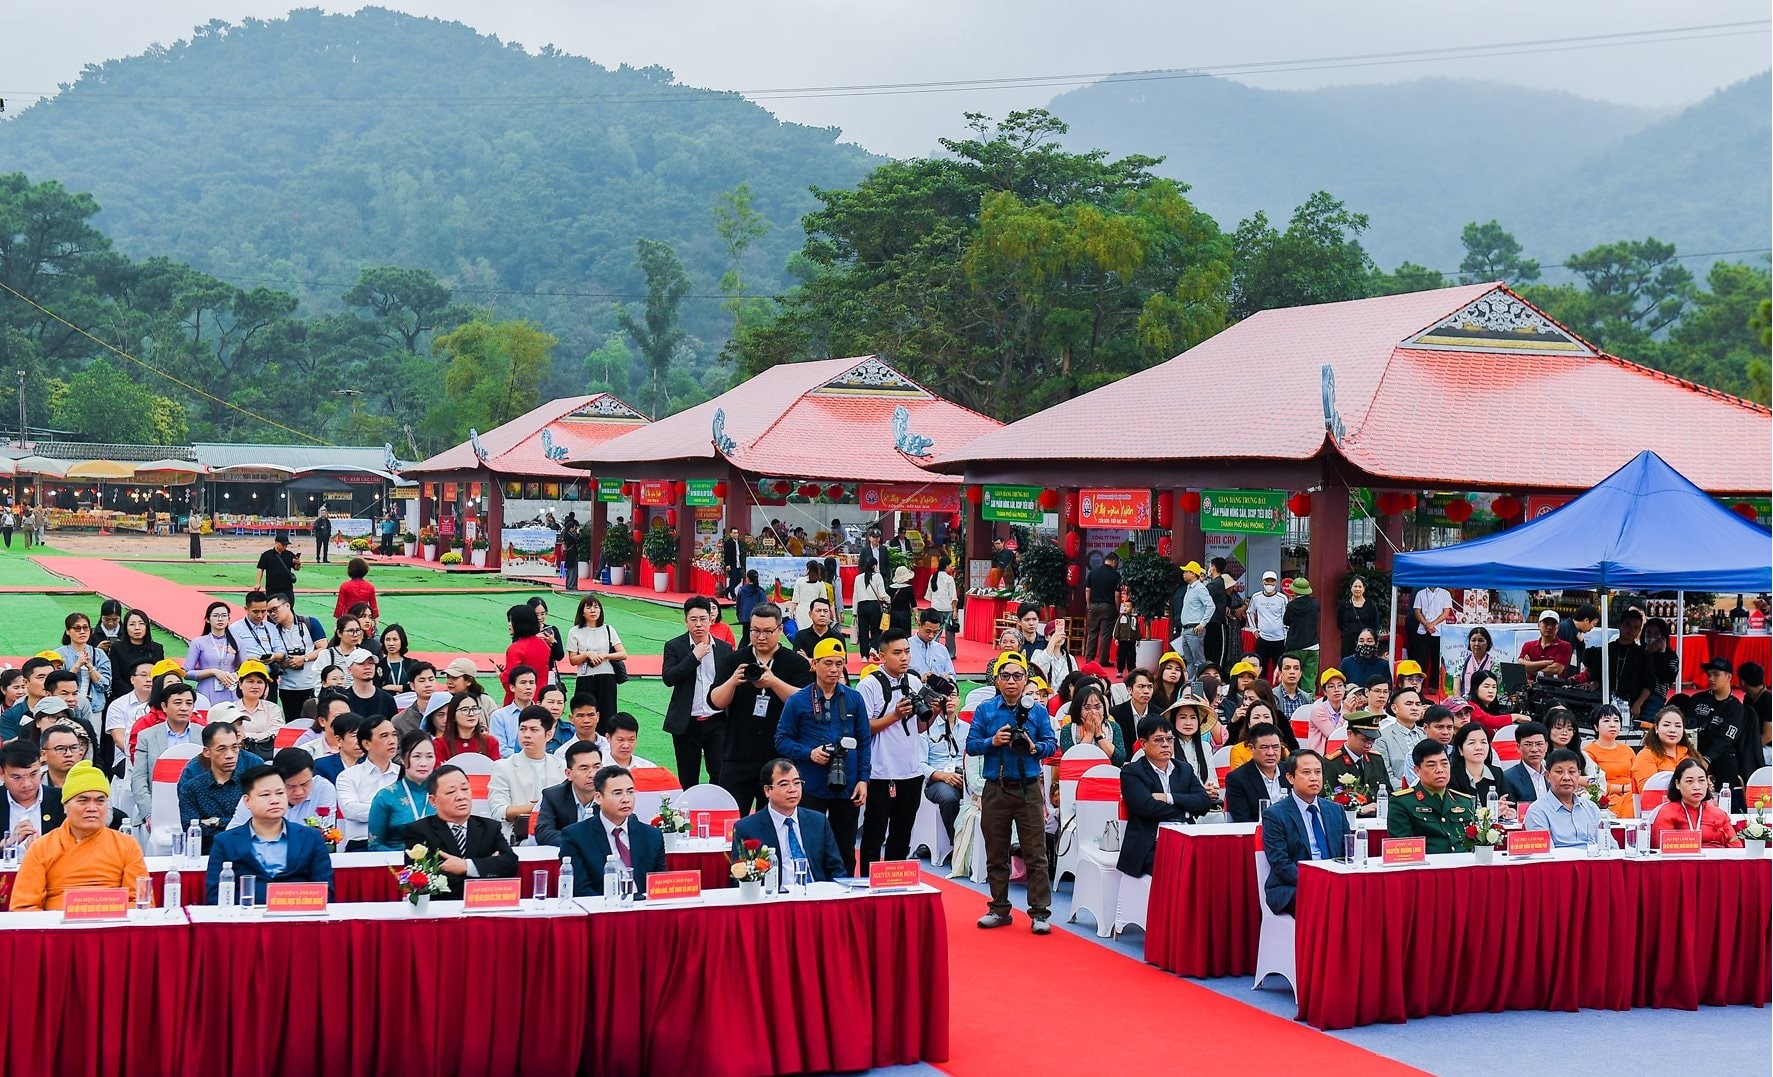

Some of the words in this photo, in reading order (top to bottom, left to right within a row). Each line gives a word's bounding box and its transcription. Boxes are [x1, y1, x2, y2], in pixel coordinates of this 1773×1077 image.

[1230, 495, 1241, 503] HÀNG
[1243, 496, 1257, 504] TRƯNG
[1258, 495, 1267, 504] BÀY
[1220, 504, 1229, 517] PHẨM
[1230, 506, 1239, 517] NÔNG
[1248, 508, 1257, 518] OCOP
[1257, 507, 1265, 518] TIÊU
[1265, 505, 1273, 519] BIỂU
[1234, 519, 1242, 528] PHỐ
[1250, 520, 1264, 529] PHÒNG
[873, 870, 891, 878] NGUYỄN
[904, 868, 917, 877] HÙNG
